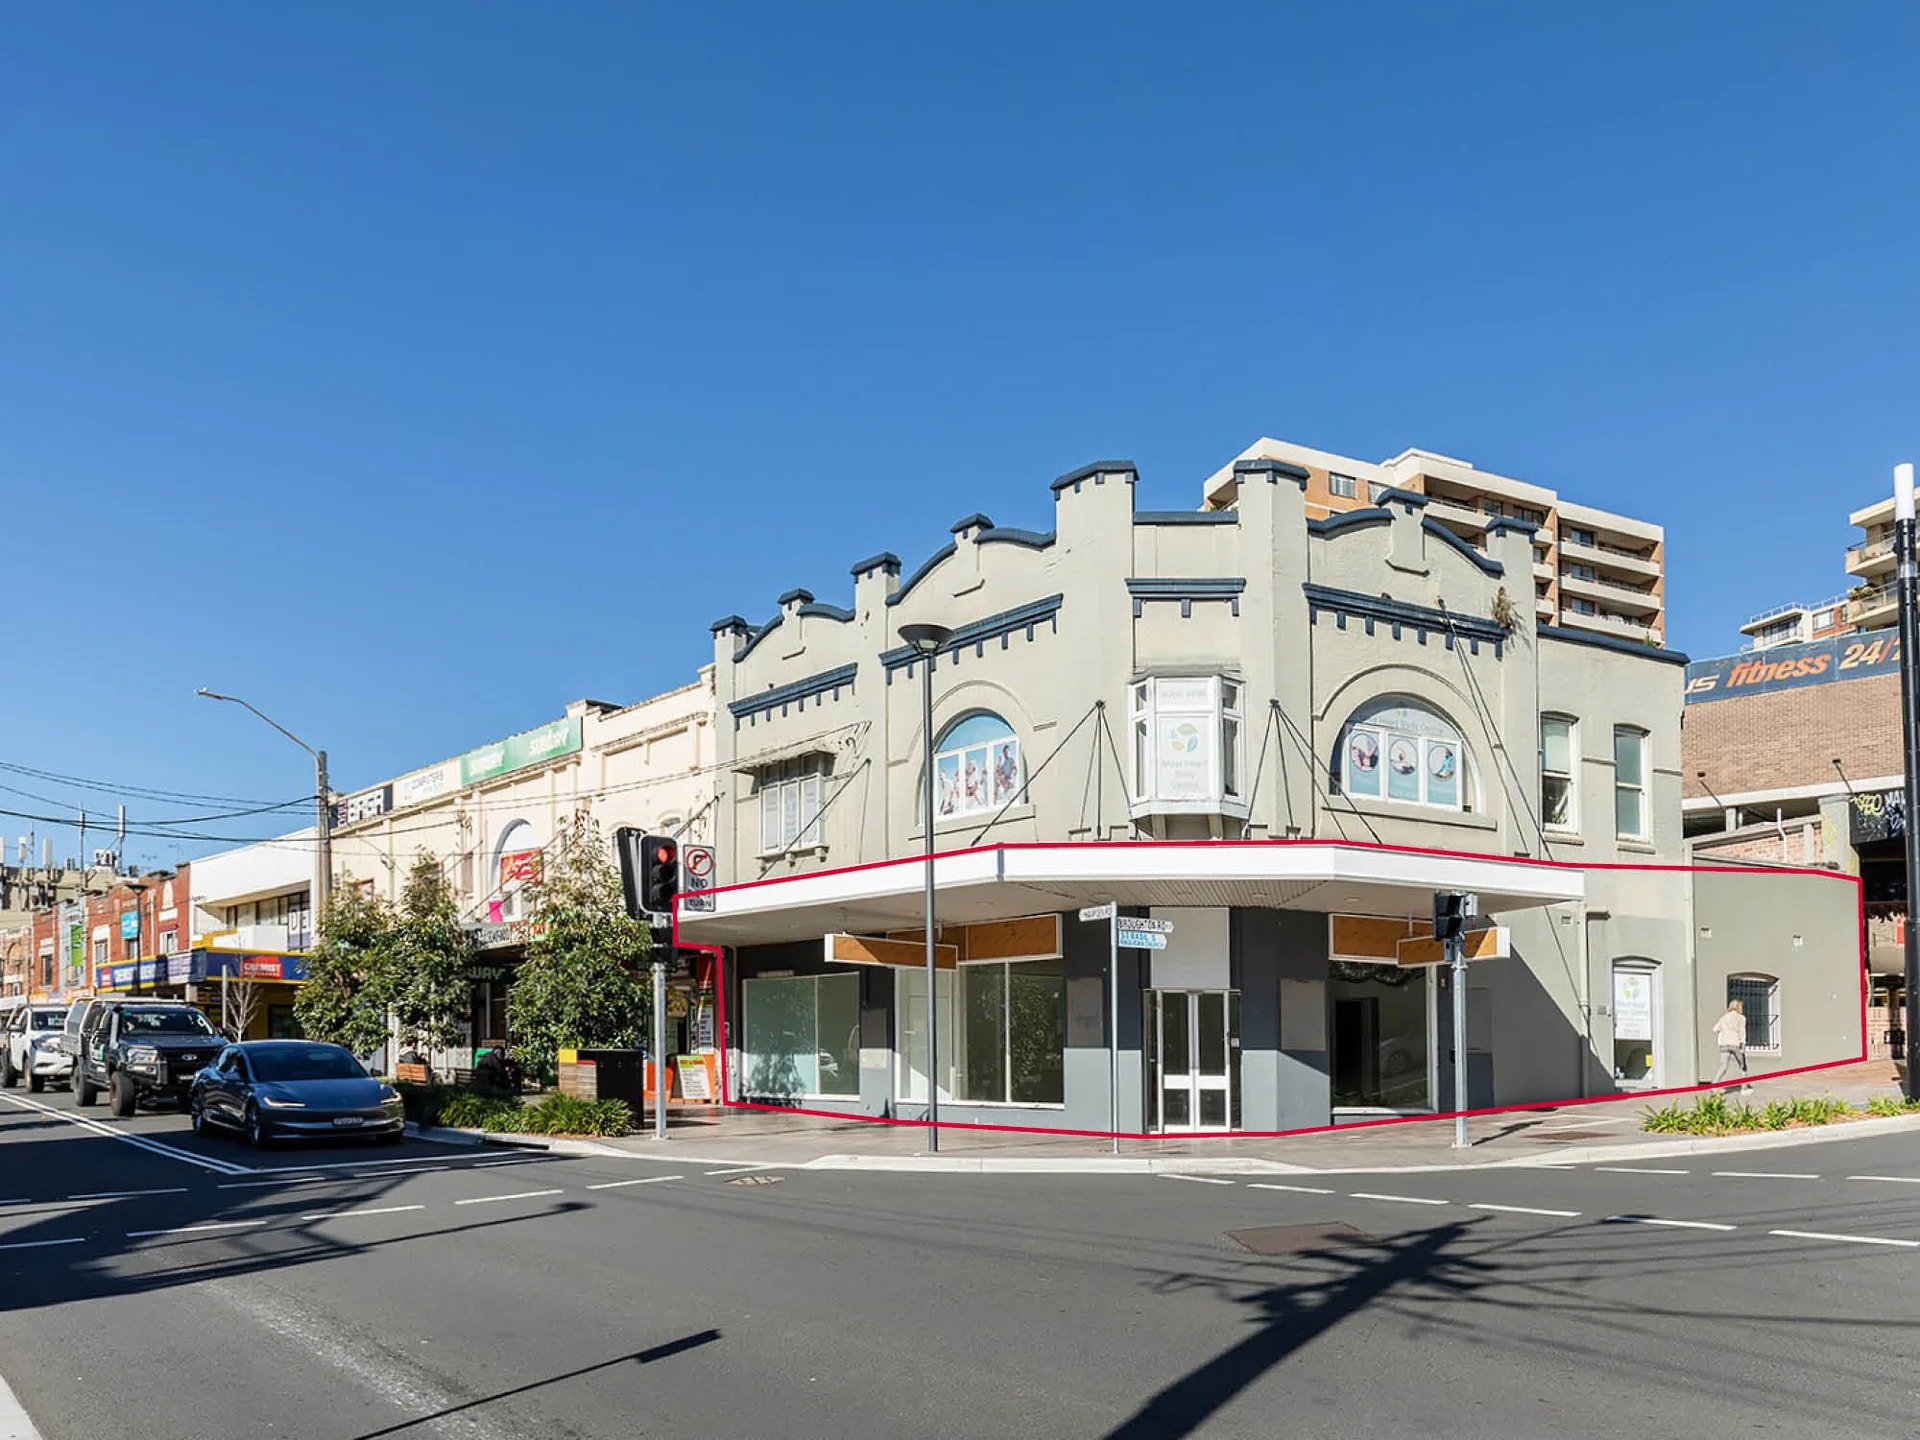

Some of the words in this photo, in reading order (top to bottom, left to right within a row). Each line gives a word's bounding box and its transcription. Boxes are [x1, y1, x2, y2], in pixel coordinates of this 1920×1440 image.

[1726, 654, 1832, 688] fitness
[691, 878, 708, 889] NO
[1118, 918, 1157, 930] BROUGHTON
